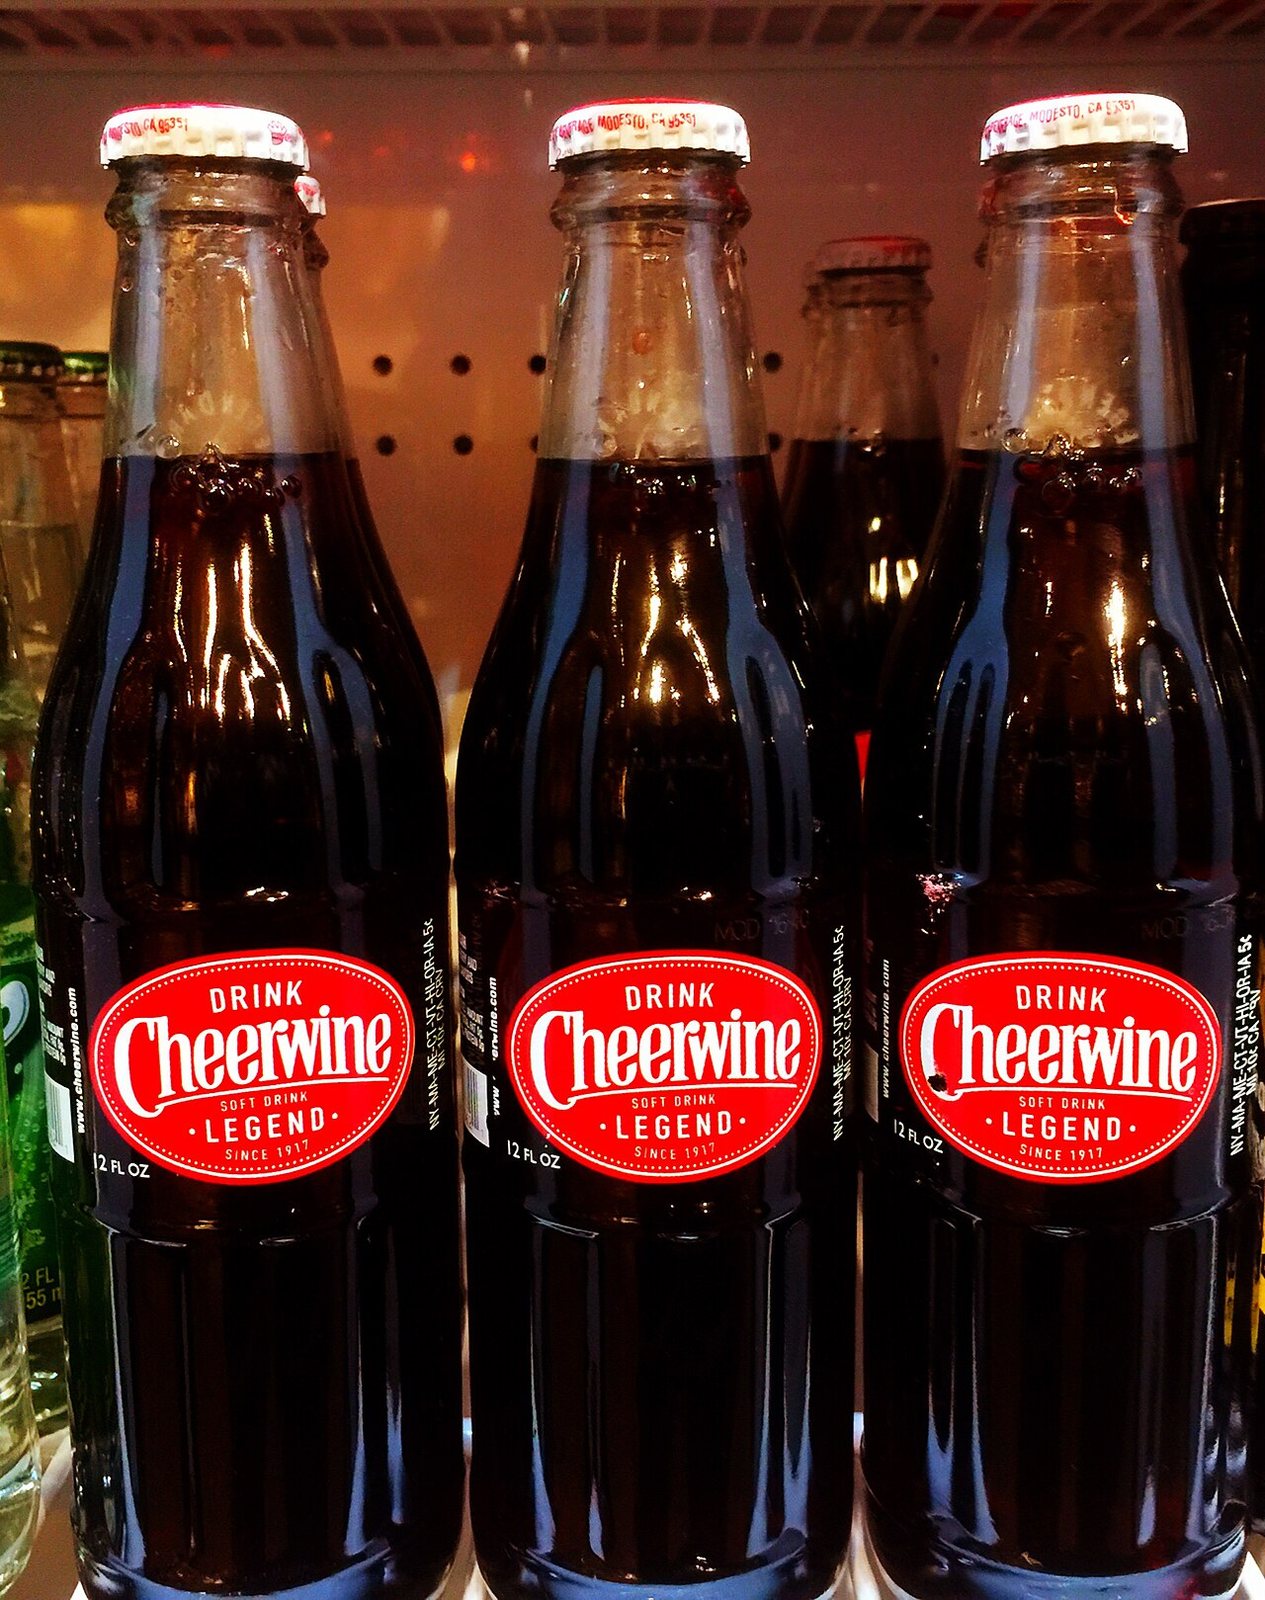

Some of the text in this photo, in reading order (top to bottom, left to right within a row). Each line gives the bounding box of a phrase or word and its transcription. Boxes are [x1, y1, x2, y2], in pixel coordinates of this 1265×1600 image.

[144, 118, 157, 132] CA
[1030, 104, 1084, 124] MODESTO,
[1088, 102, 1102, 114] CA
[435, 968, 444, 998] CRV
[843, 976, 852, 1007] CRV
[210, 980, 303, 1013] DRINK
[625, 983, 715, 1011] DRINK
[1016, 984, 1107, 1013] DRINK
[436, 998, 444, 1022] CA
[843, 1006, 852, 1031] CA
[882, 959, 890, 1099] www.cheerwine.com
[1247, 1020, 1260, 1045] CA
[68, 987, 86, 1134] www.cheerwine.com
[114, 1004, 391, 1118] Cheerwine
[437, 1049, 446, 1070] MI
[530, 1008, 801, 1111] Cheerwine
[920, 1002, 1198, 1102] Cheerwine
[843, 1059, 851, 1081] MI
[1245, 1073, 1258, 1096] MI
[220, 1091, 308, 1112] SOFT DRINK
[631, 1094, 716, 1109] SOFT DRINK
[1019, 1096, 1105, 1110] SOFT DRINK
[205, 1107, 325, 1143] LEGEND
[616, 1110, 732, 1140] LEGEND
[894, 1119, 944, 1154] 12 FL OZ
[1002, 1111, 1121, 1142] LEGEND
[225, 1139, 310, 1161] SINCE 1917
[507, 1139, 561, 1170] 12 FL OZ
[634, 1142, 716, 1160] SINCE 1917
[1019, 1143, 1103, 1161] SINCE 1917
[93, 1152, 151, 1179] 12 FL OZ
[21, 1266, 55, 1290] 2 FL
[25, 1288, 47, 1310] 55
